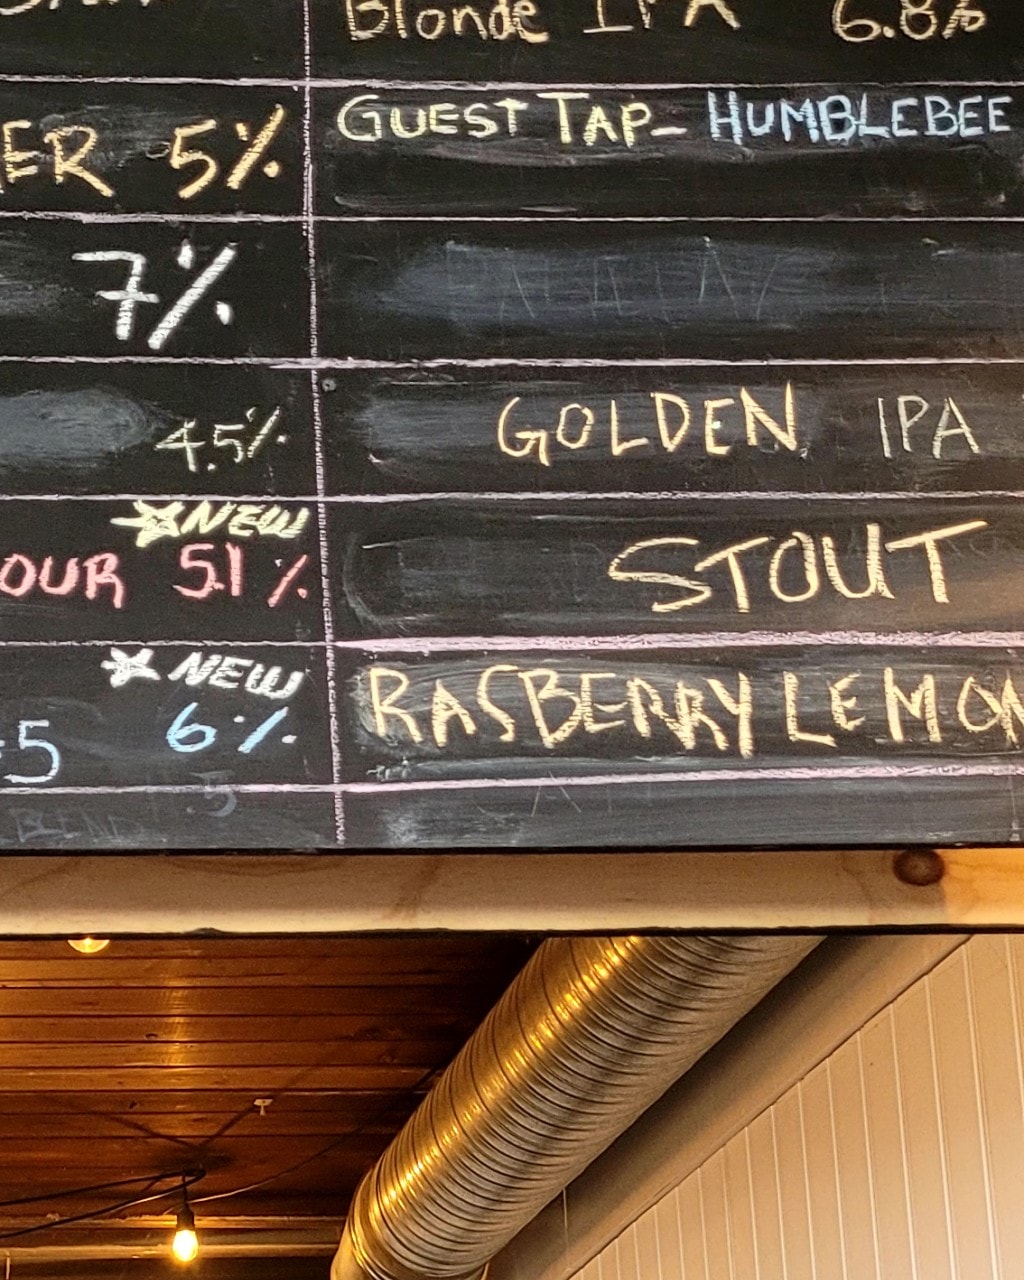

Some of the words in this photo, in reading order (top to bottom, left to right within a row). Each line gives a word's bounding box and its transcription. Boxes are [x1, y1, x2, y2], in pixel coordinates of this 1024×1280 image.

[170, 103, 285, 198] 5%
[337, 94, 528, 143] GUEST
[707, 90, 1012, 147] HUMBLEBEE
[72, 239, 236, 349] 7%
[496, 379, 798, 466] GOLDEN
[877, 394, 981, 460] IPA
[607, 519, 989, 614] STOUT
[168, 650, 311, 700] NEW
[370, 665, 755, 758] RASBERRY
